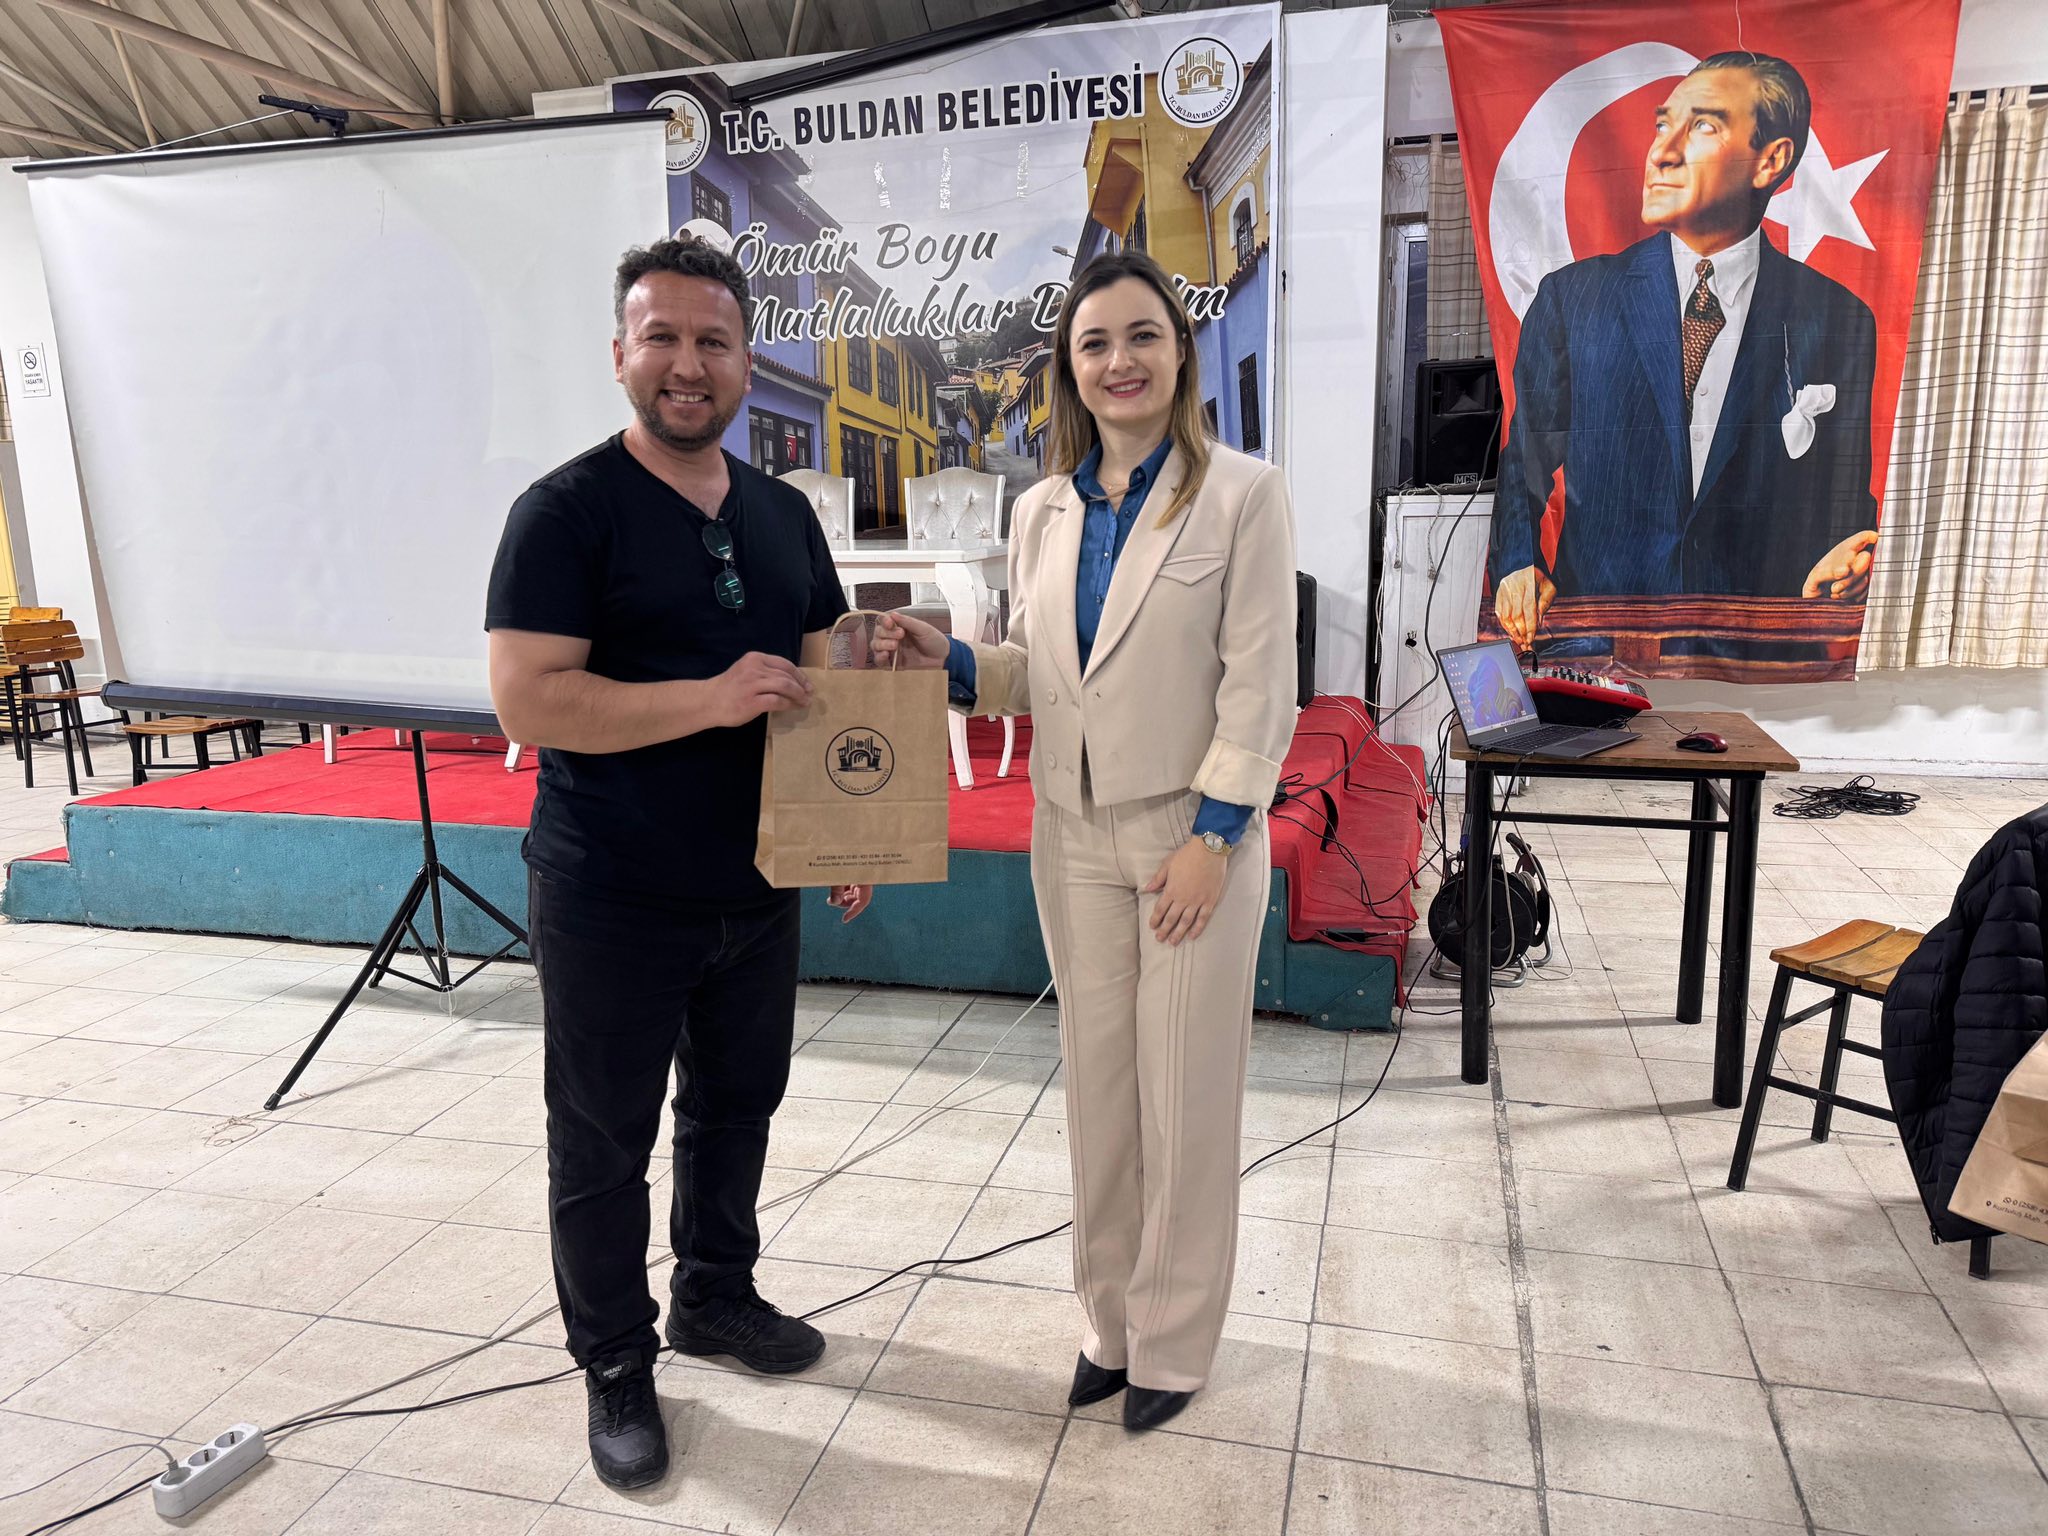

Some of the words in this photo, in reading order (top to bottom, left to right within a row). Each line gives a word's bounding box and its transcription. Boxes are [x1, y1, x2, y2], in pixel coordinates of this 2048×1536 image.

[722, 110, 782, 152] T.C.
[793, 95, 925, 146] BULDAN
[937, 62, 1142, 132] BELEDİYESİ
[1176, 106, 1201, 119] BULDAN
[1201, 88, 1233, 119] BELEDİYESİ
[678, 140, 703, 167] BELEDİYESİ
[732, 225, 858, 276] Ömür
[876, 223, 998, 282] Boyu
[1456, 475, 1475, 483] MCS
